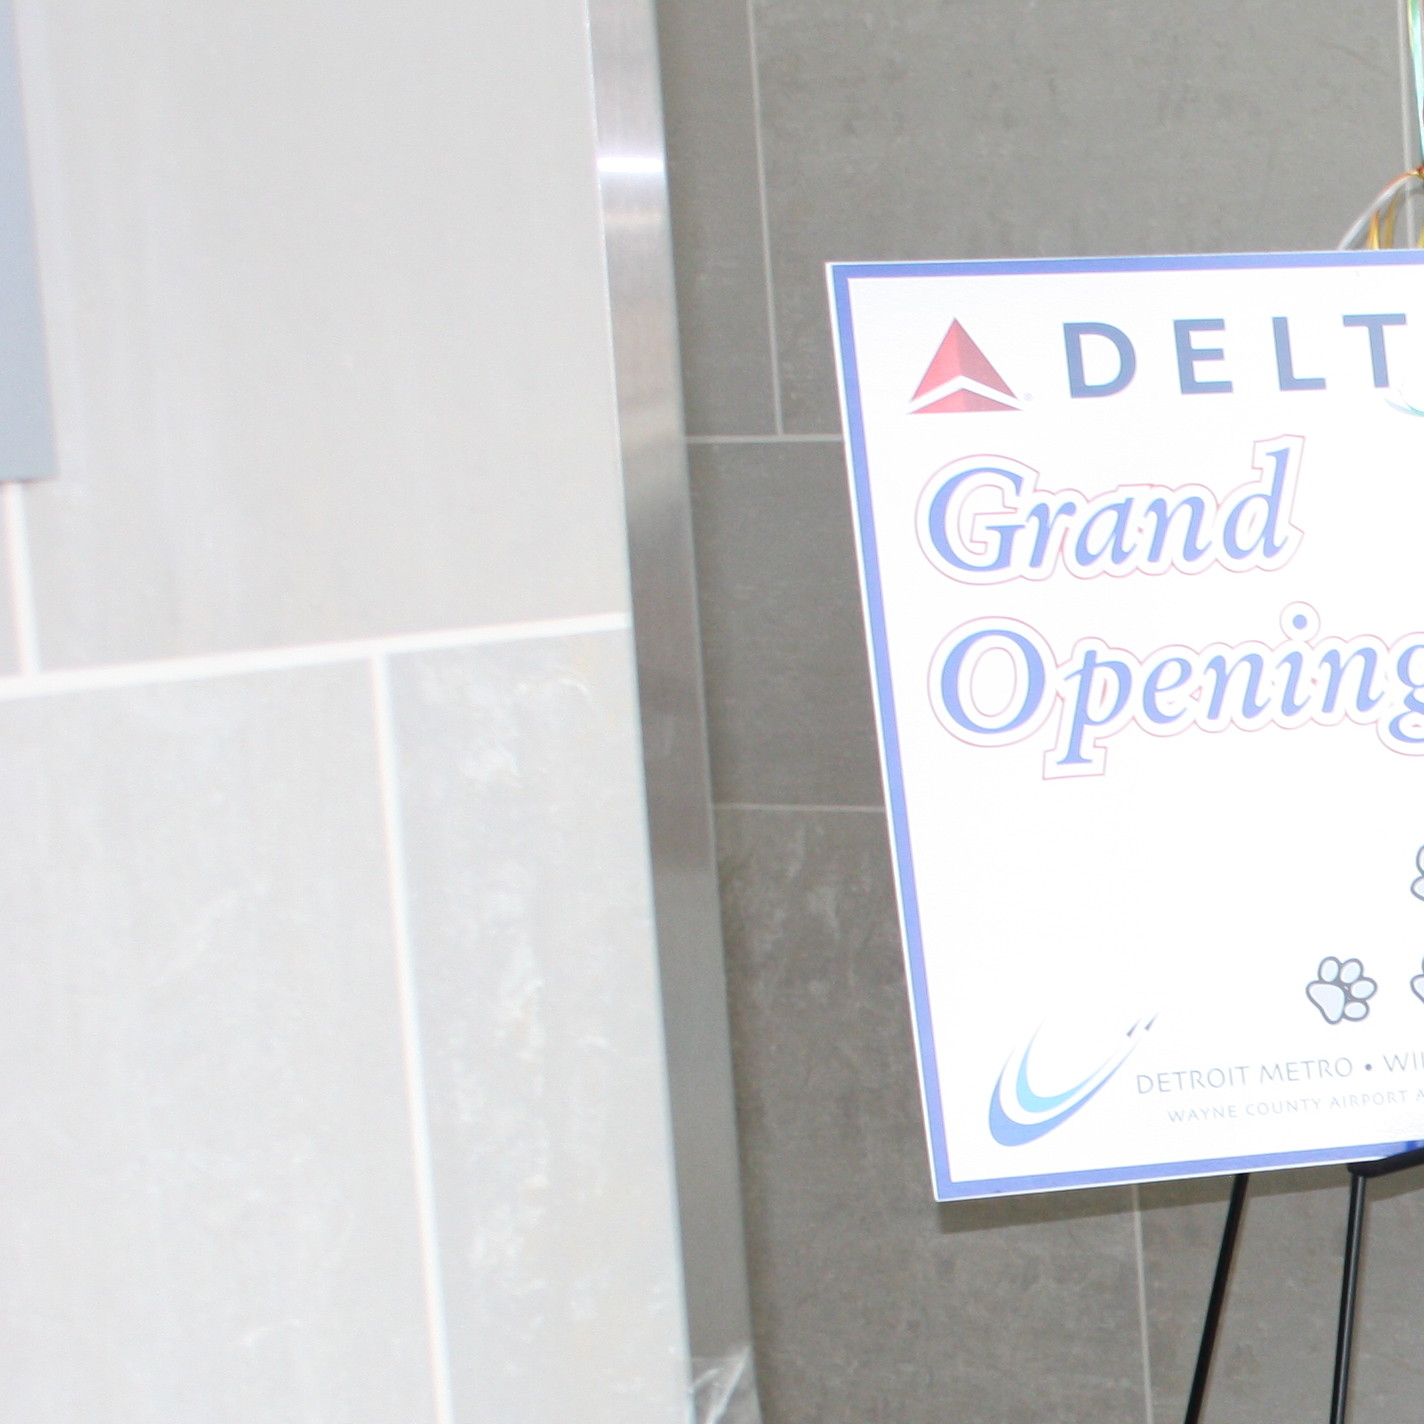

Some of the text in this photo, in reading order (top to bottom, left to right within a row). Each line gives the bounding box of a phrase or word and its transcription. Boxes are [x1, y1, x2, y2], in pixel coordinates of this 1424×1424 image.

[921, 440, 1298, 579] Grand
[1136, 1065, 1250, 1095] DETROIT
[1259, 1056, 1354, 1085] METRO
[1166, 1104, 1238, 1124] WAYNE
[1245, 1097, 1323, 1118] COUNTY
[1329, 1089, 1408, 1110] AIRPORT
